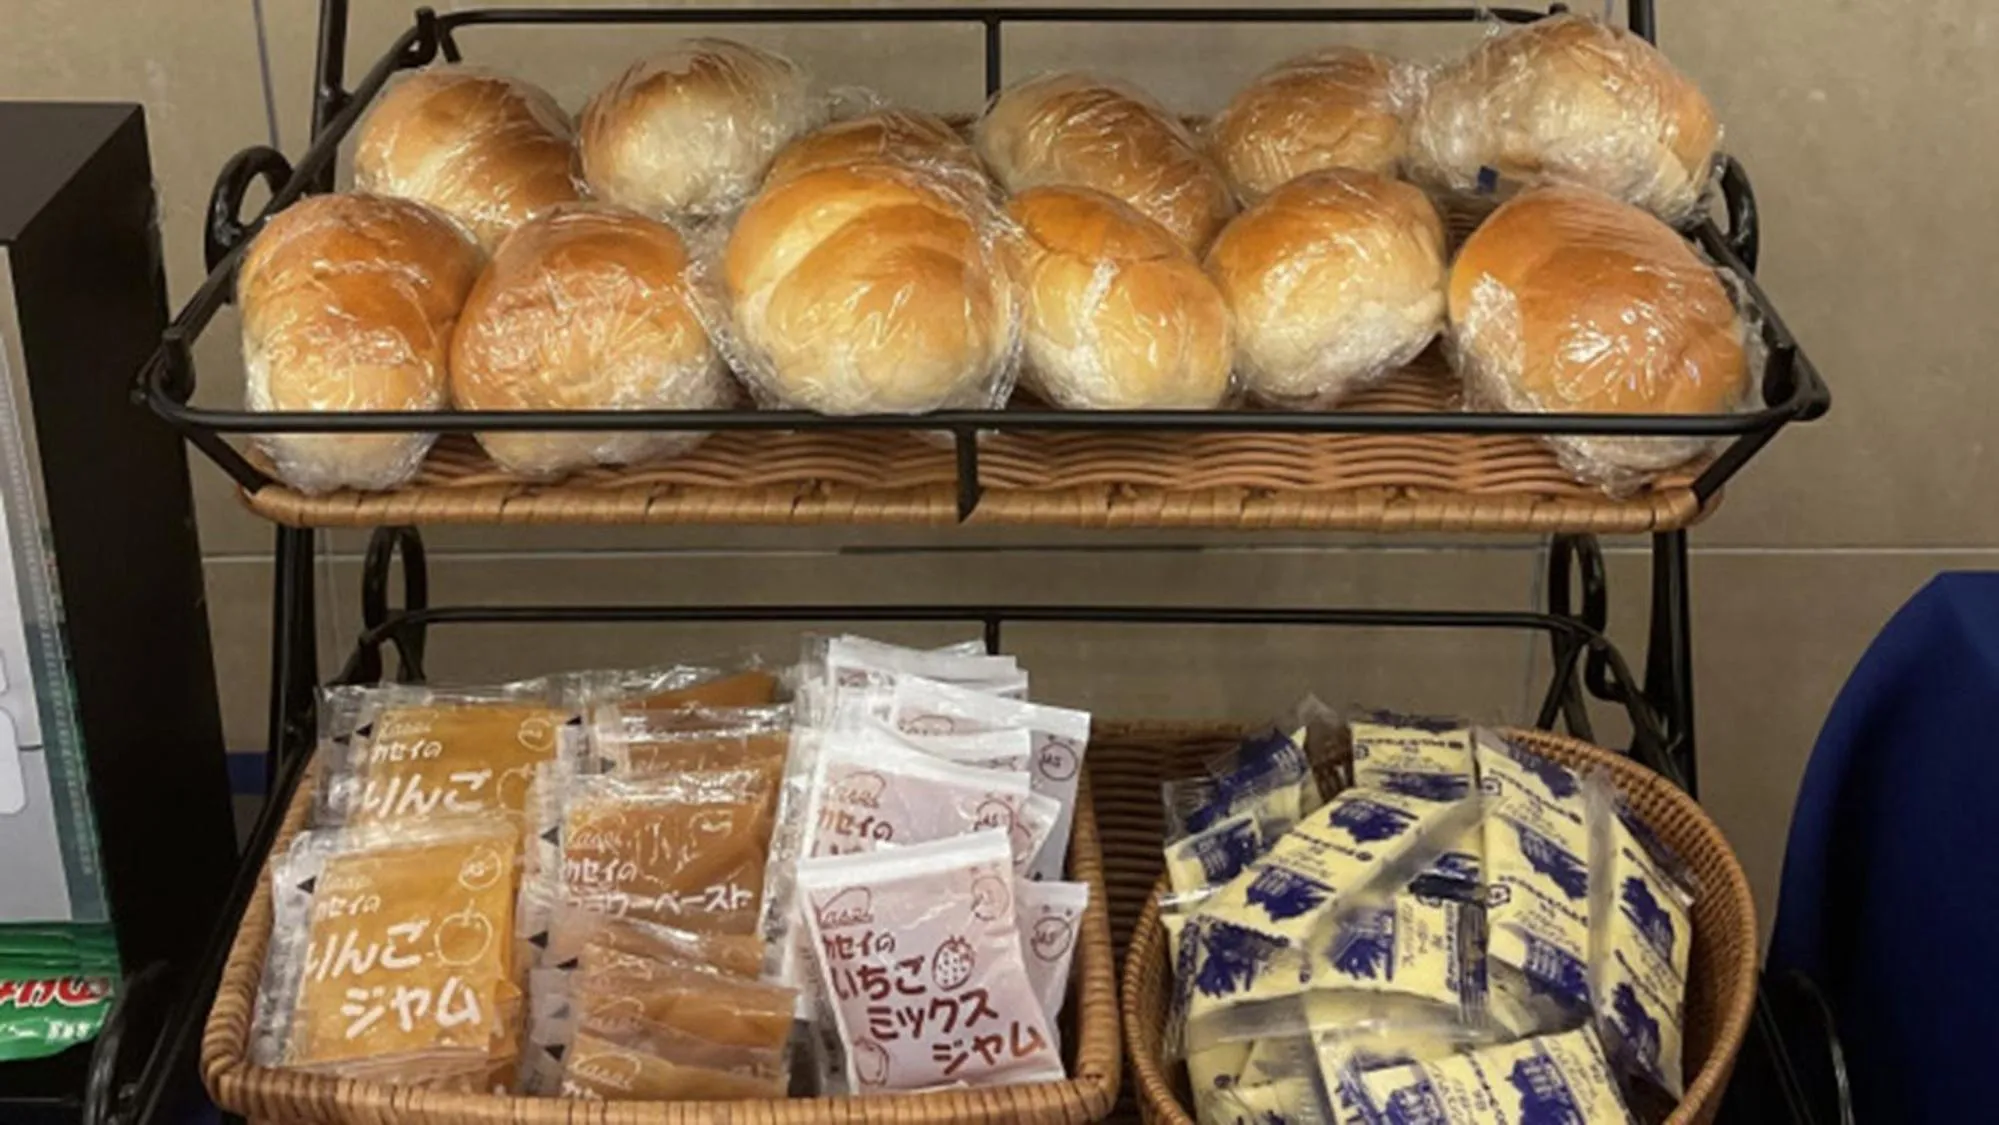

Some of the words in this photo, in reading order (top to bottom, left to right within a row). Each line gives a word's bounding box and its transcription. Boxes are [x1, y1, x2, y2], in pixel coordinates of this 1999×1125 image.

[304, 918, 430, 981] りんご
[830, 955, 927, 1000] いちご
[341, 976, 482, 1038] ジャム
[866, 988, 999, 1040] ミックス
[931, 1020, 1047, 1076] ジャム
